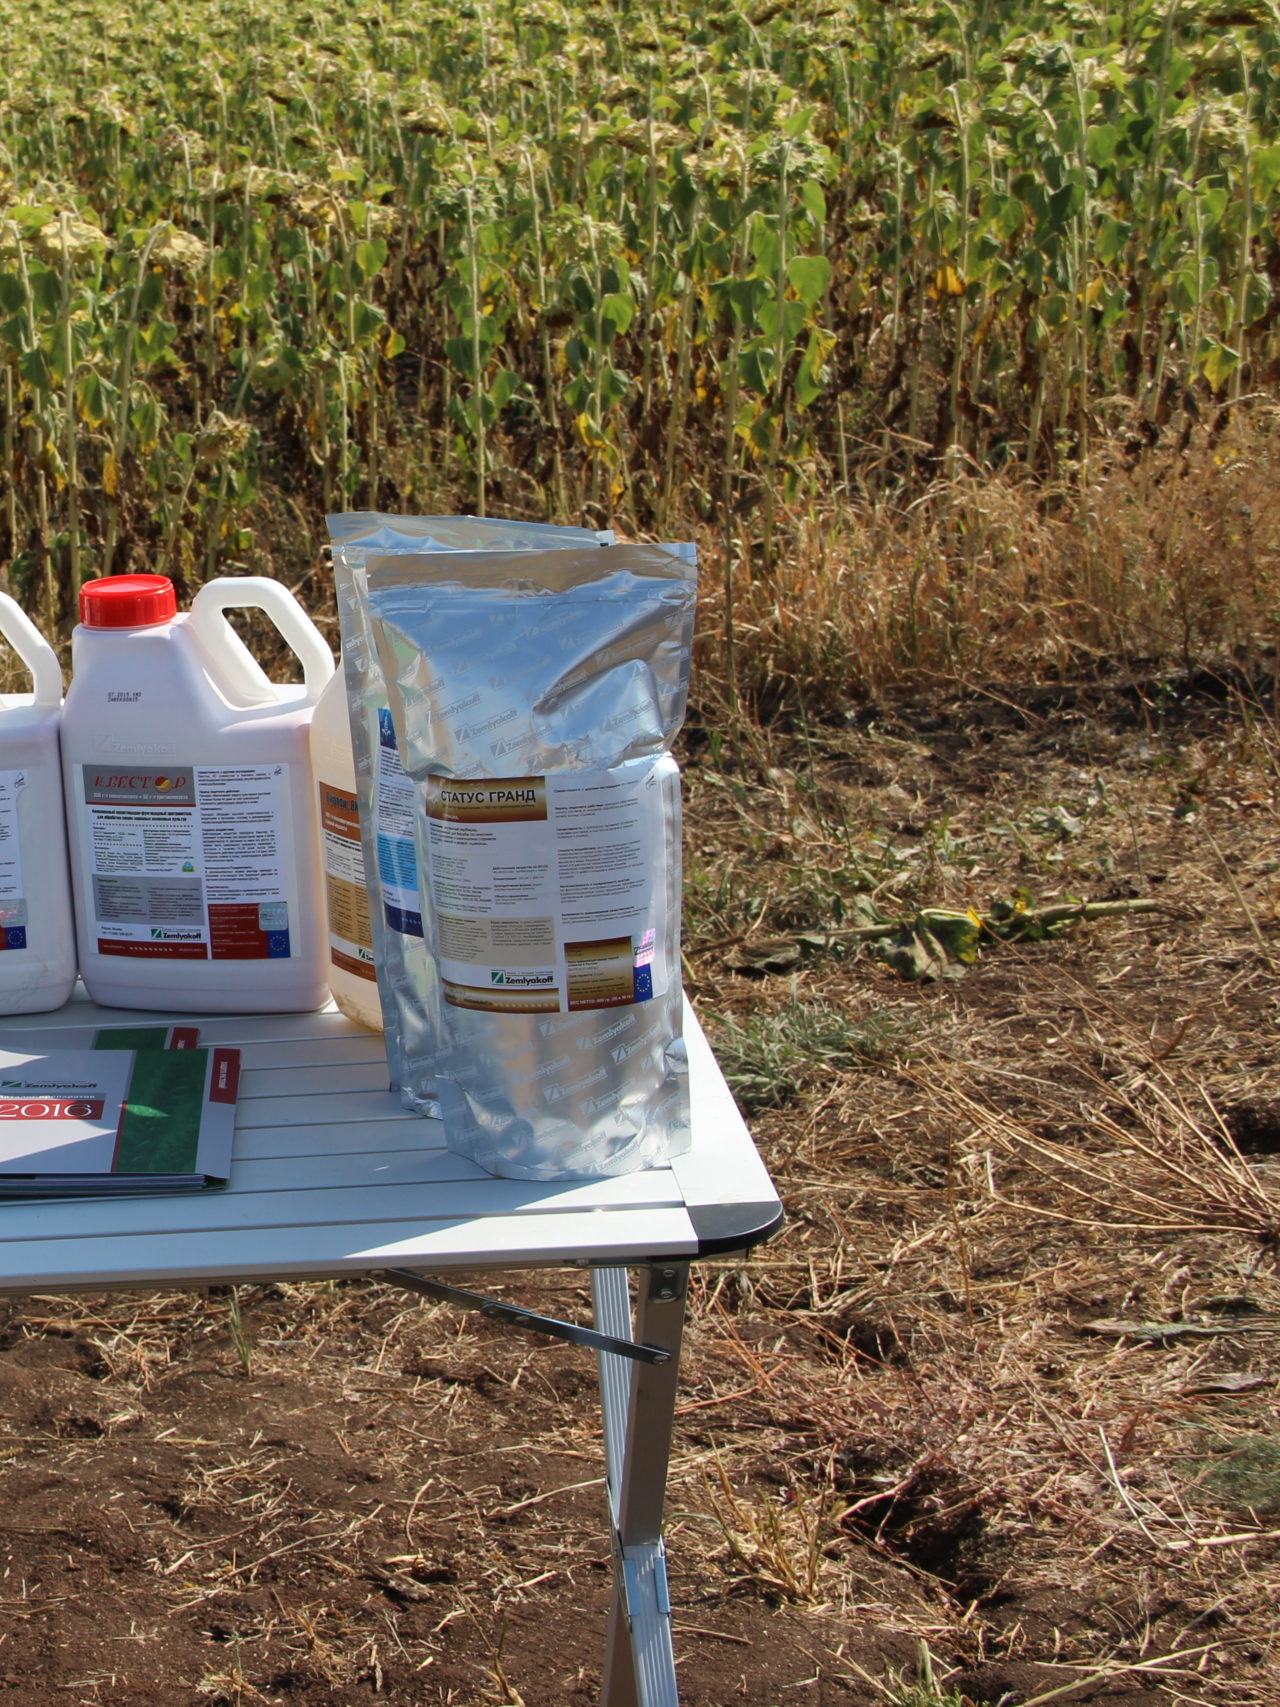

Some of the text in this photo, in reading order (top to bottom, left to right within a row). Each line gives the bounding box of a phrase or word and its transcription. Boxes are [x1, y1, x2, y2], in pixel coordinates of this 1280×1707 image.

[471, 708, 519, 737] Zemlyakoff
[441, 789, 537, 804] СТАТУС ГРАНД
[163, 932, 202, 940] Zemlyakoff
[505, 976, 554, 986] Zemlyakoff
[594, 1013, 638, 1044] Zemlyakoff
